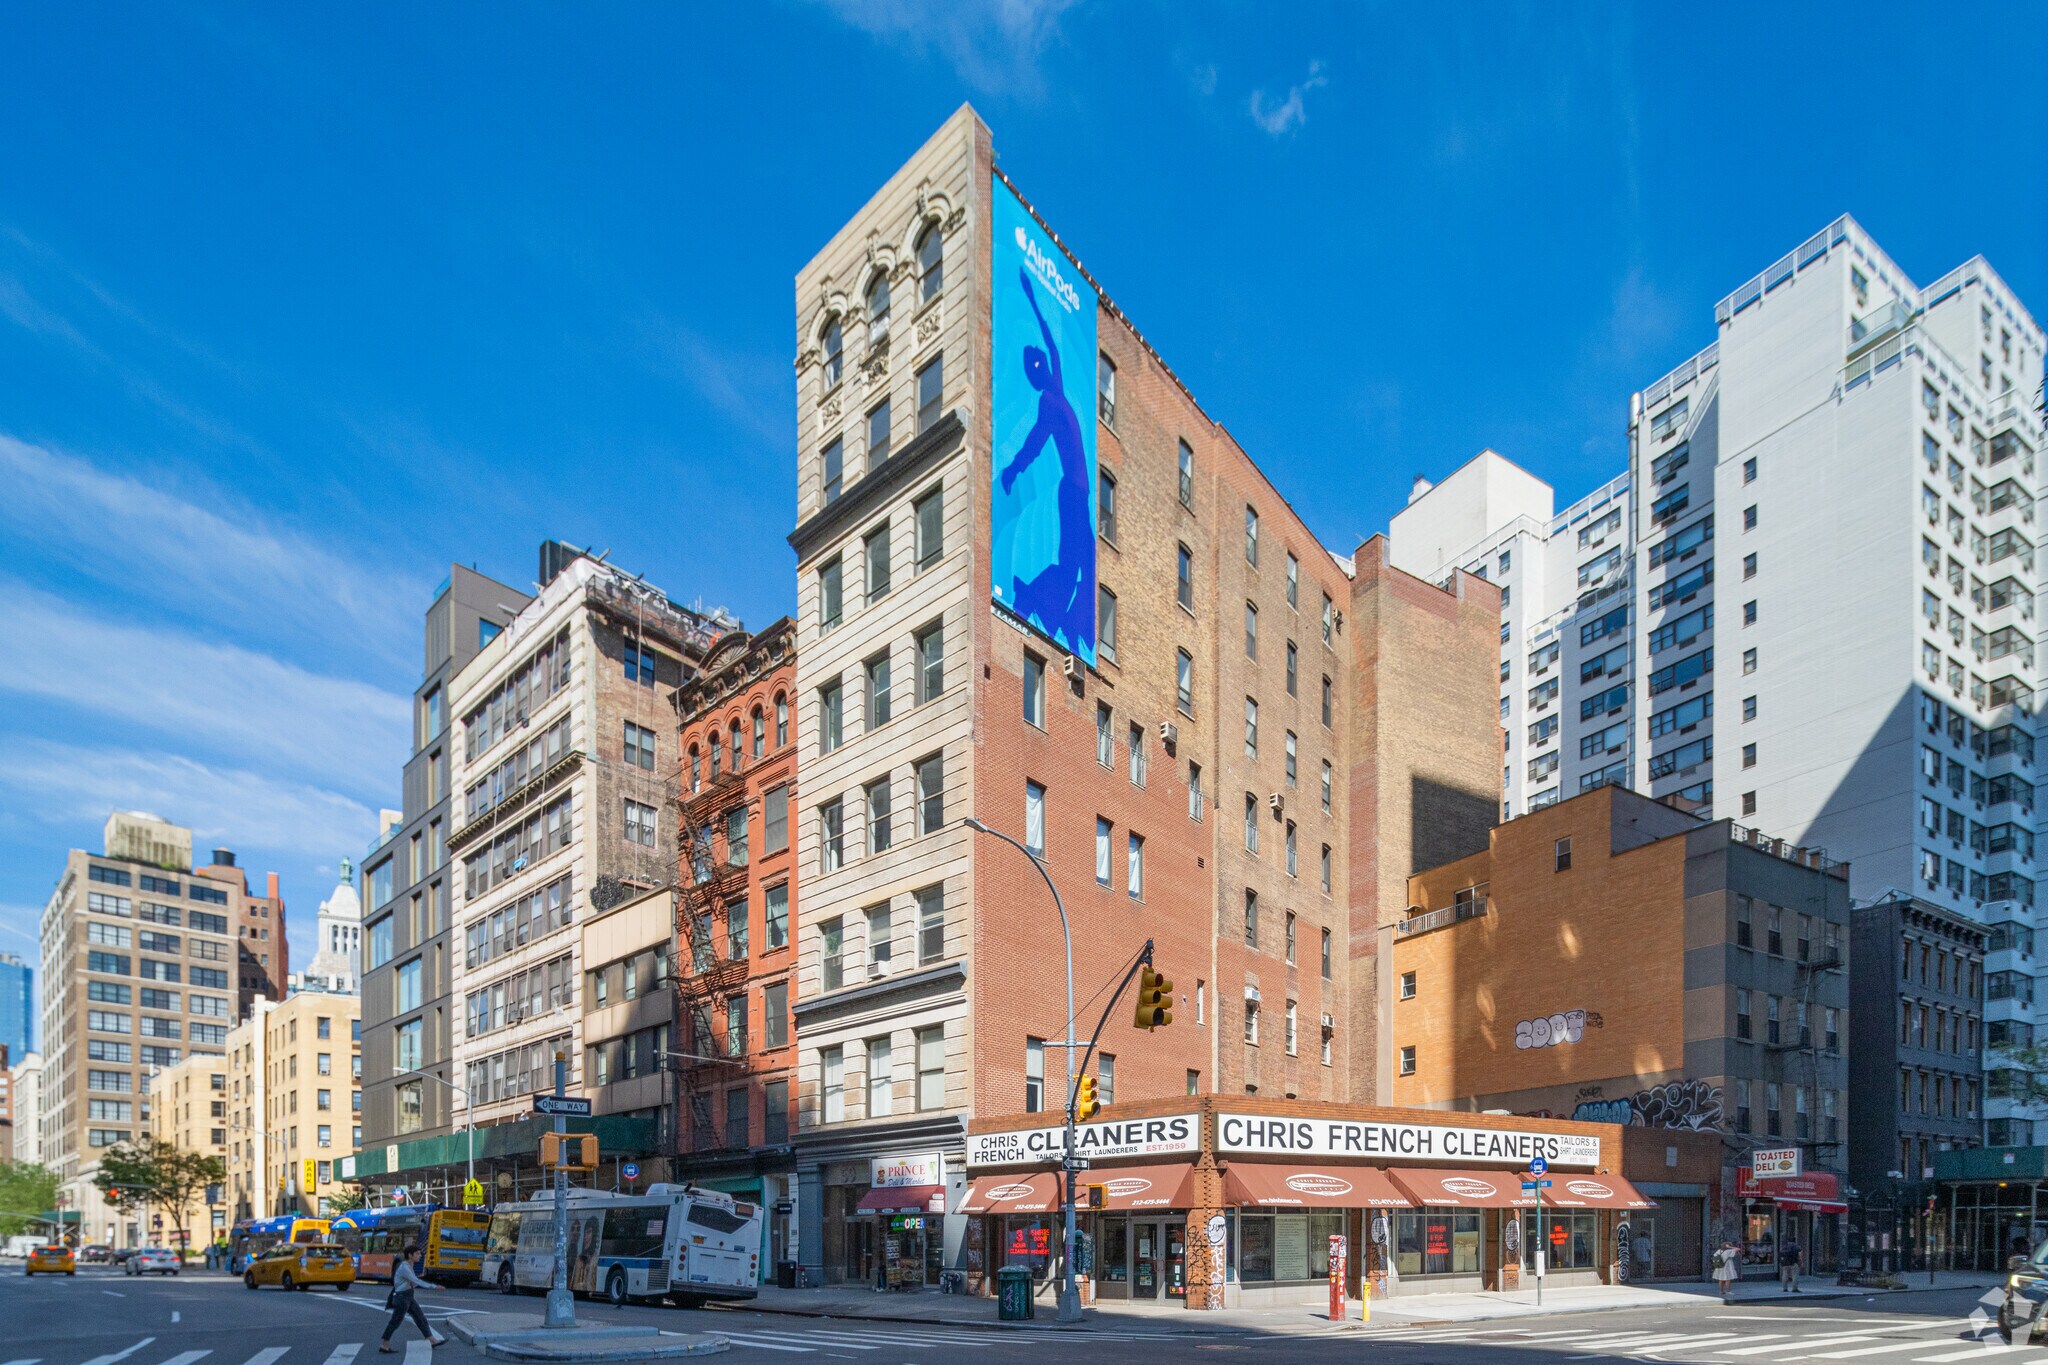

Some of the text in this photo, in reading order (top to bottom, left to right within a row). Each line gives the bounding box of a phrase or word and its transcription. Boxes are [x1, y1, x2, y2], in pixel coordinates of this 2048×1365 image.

[1026, 238, 1080, 311] AirPods
[542, 1100, 585, 1111] ONE WAY
[980, 1134, 1018, 1150] CHRIS
[1223, 1118, 1559, 1160] CHRIS FRENCH CLEANERS
[1560, 1136, 1597, 1147] TAILORS &
[974, 1147, 1025, 1163] FRENCH
[1036, 1151, 1064, 1160] TAILORS
[1095, 1146, 1138, 1156] LAUNDERERS
[1755, 1150, 1795, 1161] TOASTED
[887, 1164, 926, 1177] PRINCE
[1755, 1162, 1775, 1172] DELI
[887, 1178, 899, 1187] Deli
[905, 1176, 925, 1186] Market
[1015, 1229, 1024, 1242] 3
